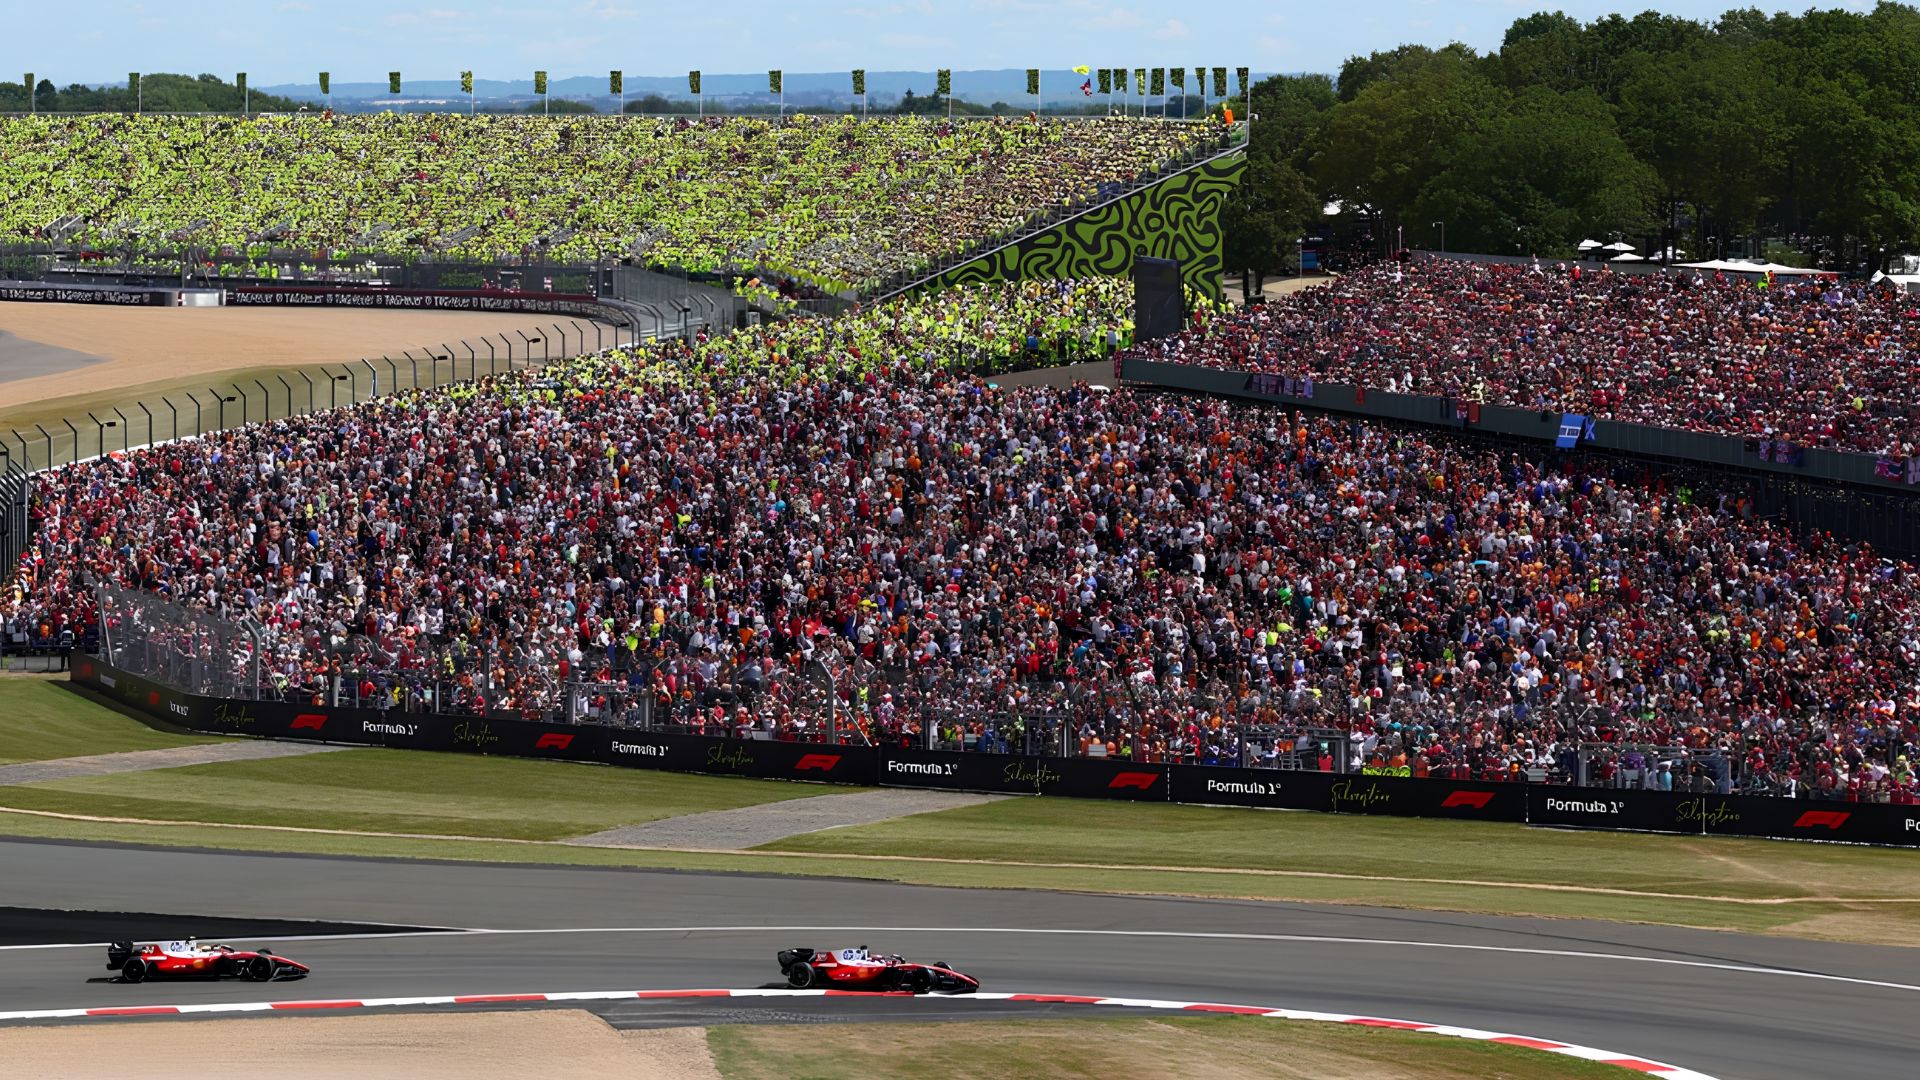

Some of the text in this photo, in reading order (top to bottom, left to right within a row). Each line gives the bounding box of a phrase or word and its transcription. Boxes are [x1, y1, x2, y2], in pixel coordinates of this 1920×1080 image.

[888, 760, 942, 775] Formula
[1207, 779, 1265, 794] Formula
[1547, 798, 1607, 813] Formula
